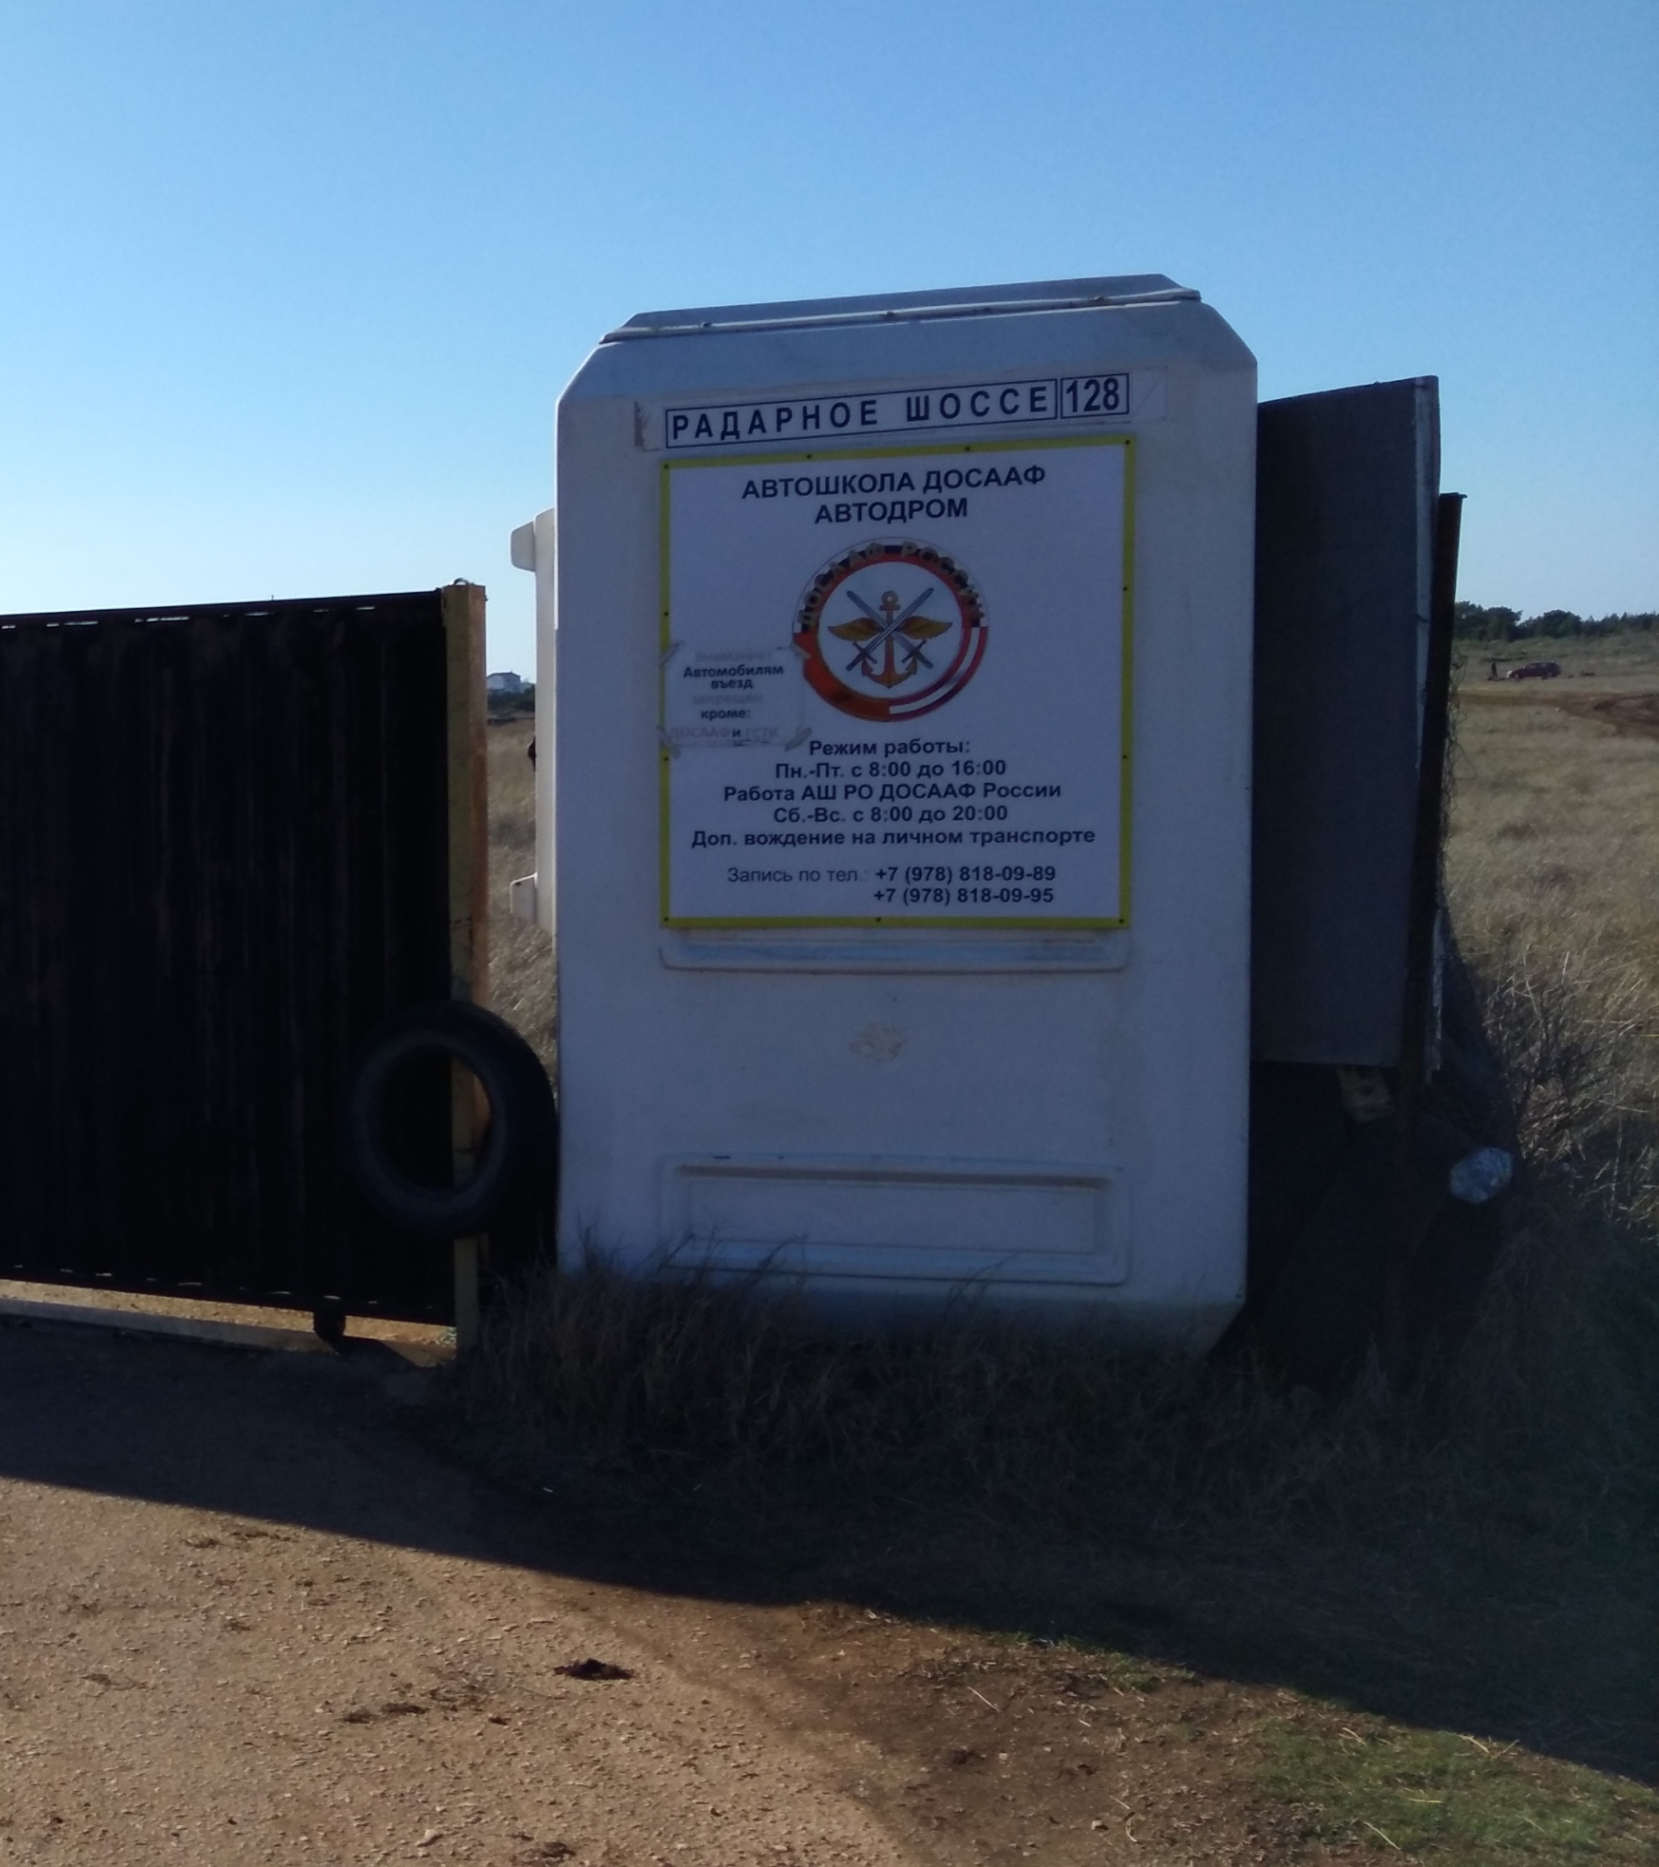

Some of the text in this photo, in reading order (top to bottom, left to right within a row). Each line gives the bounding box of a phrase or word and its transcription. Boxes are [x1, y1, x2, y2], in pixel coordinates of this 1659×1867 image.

[672, 377, 1120, 441] РАДАРНОЕ ШОССЕ 128
[742, 465, 1045, 499] АВТОШКОЛА ДОСААФ
[815, 498, 967, 524] АВТОДРОМ
[683, 664, 784, 678] Автомобилям
[711, 679, 753, 690] въезд
[732, 728, 741, 738] и
[809, 737, 970, 759] Режим работы:
[775, 759, 1007, 779] Пн.-Пт. с 8:00 до 16:00
[724, 782, 1061, 803] Работа АШ РО ДОСААФ России
[773, 804, 1008, 824] Сб.-Вс. с 8:00 до 20:00
[691, 830, 1096, 849] Доп. вождение на личном транспорте
[727, 867, 793, 884] Запись
[798, 868, 821, 884] по
[875, 866, 899, 882] +7
[904, 866, 953, 885] (978)
[959, 865, 1056, 882] 818-09-89
[873, 887, 1054, 907] +7 (978) 818-09-95
